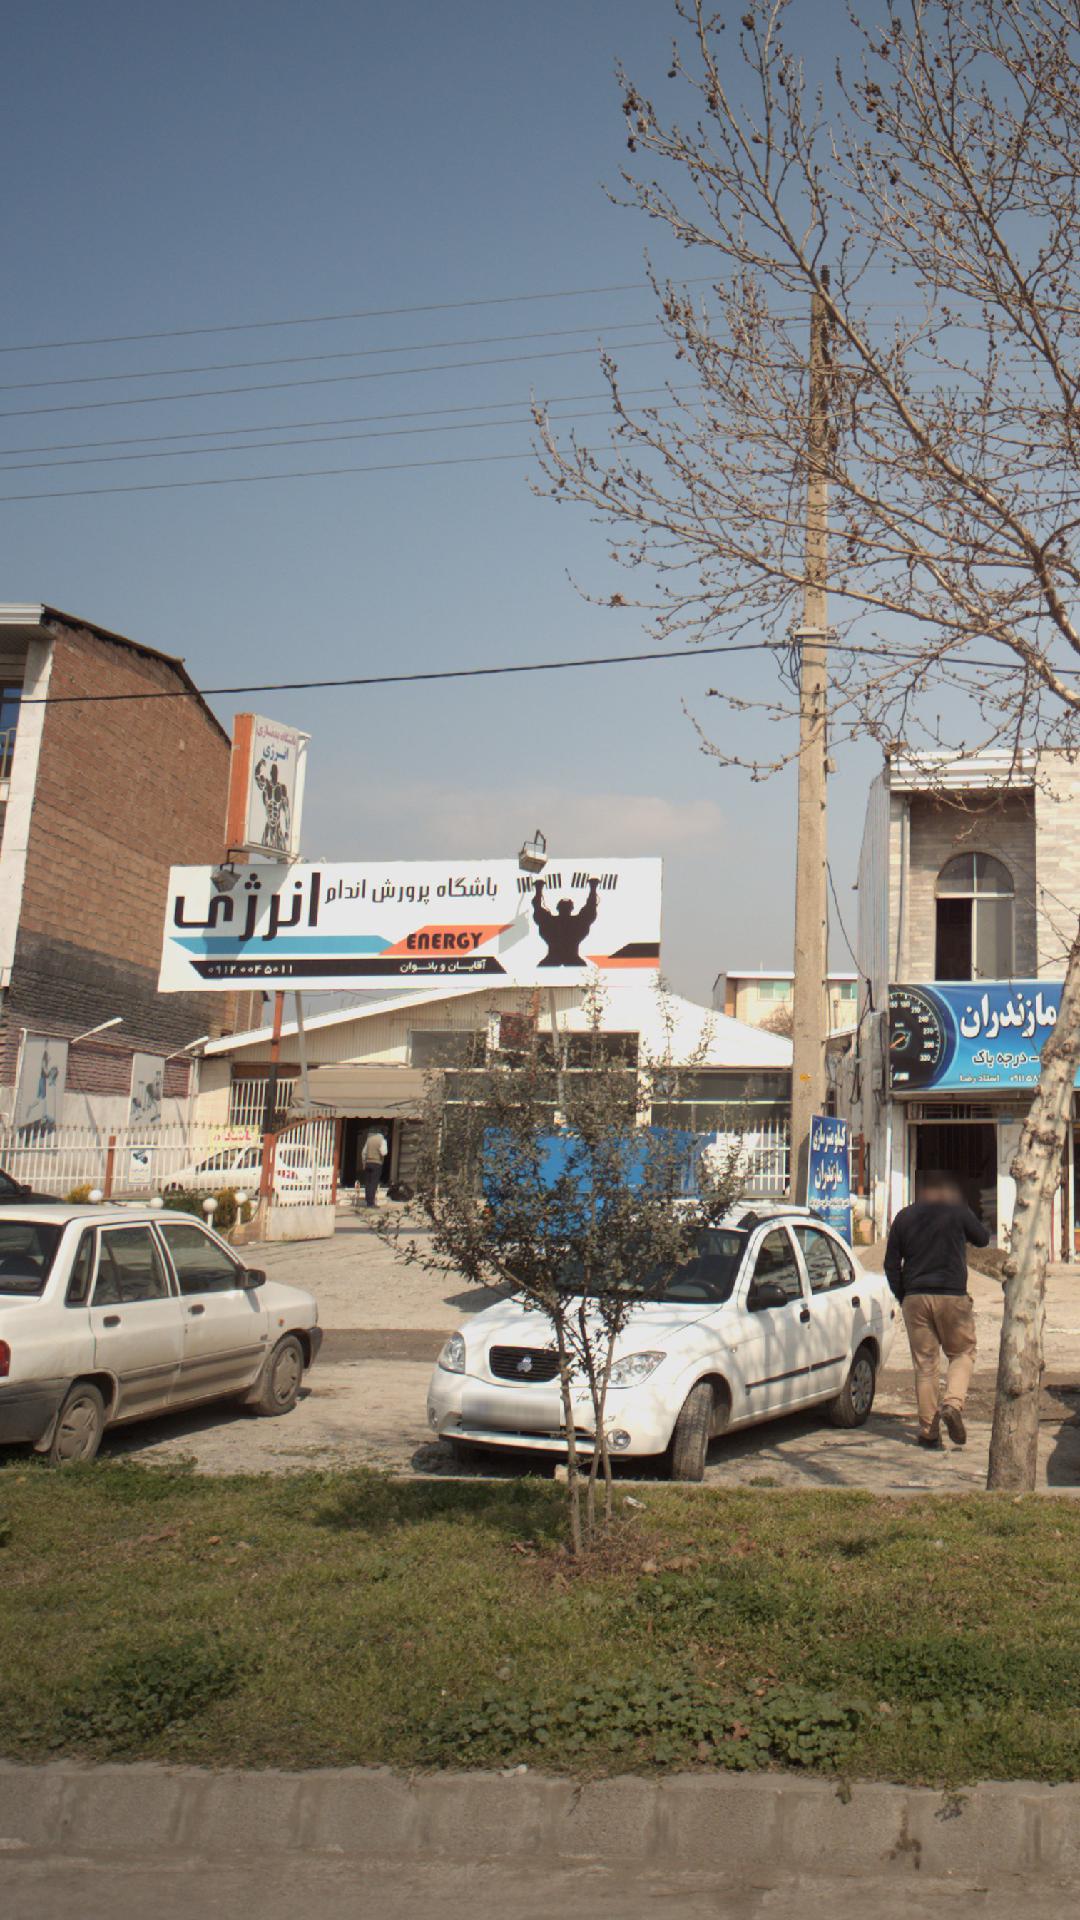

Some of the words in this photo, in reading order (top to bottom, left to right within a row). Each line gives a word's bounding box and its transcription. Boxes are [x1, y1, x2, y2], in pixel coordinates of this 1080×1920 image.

[263, 744, 288, 761] انرژی
[325, 878, 367, 905] اندام
[371, 878, 430, 905] پرورش
[436, 876, 498, 902] باشگاه
[174, 871, 321, 942] انرژی
[406, 932, 483, 950] ENERGY
[399, 959, 438, 973] بانوان
[439, 962, 446, 972] و
[447, 958, 487, 972] آقایان
[960, 991, 1057, 1039] مازندران
[997, 1050, 1028, 1068] درجه
[815, 1159, 843, 1190] مازندران
